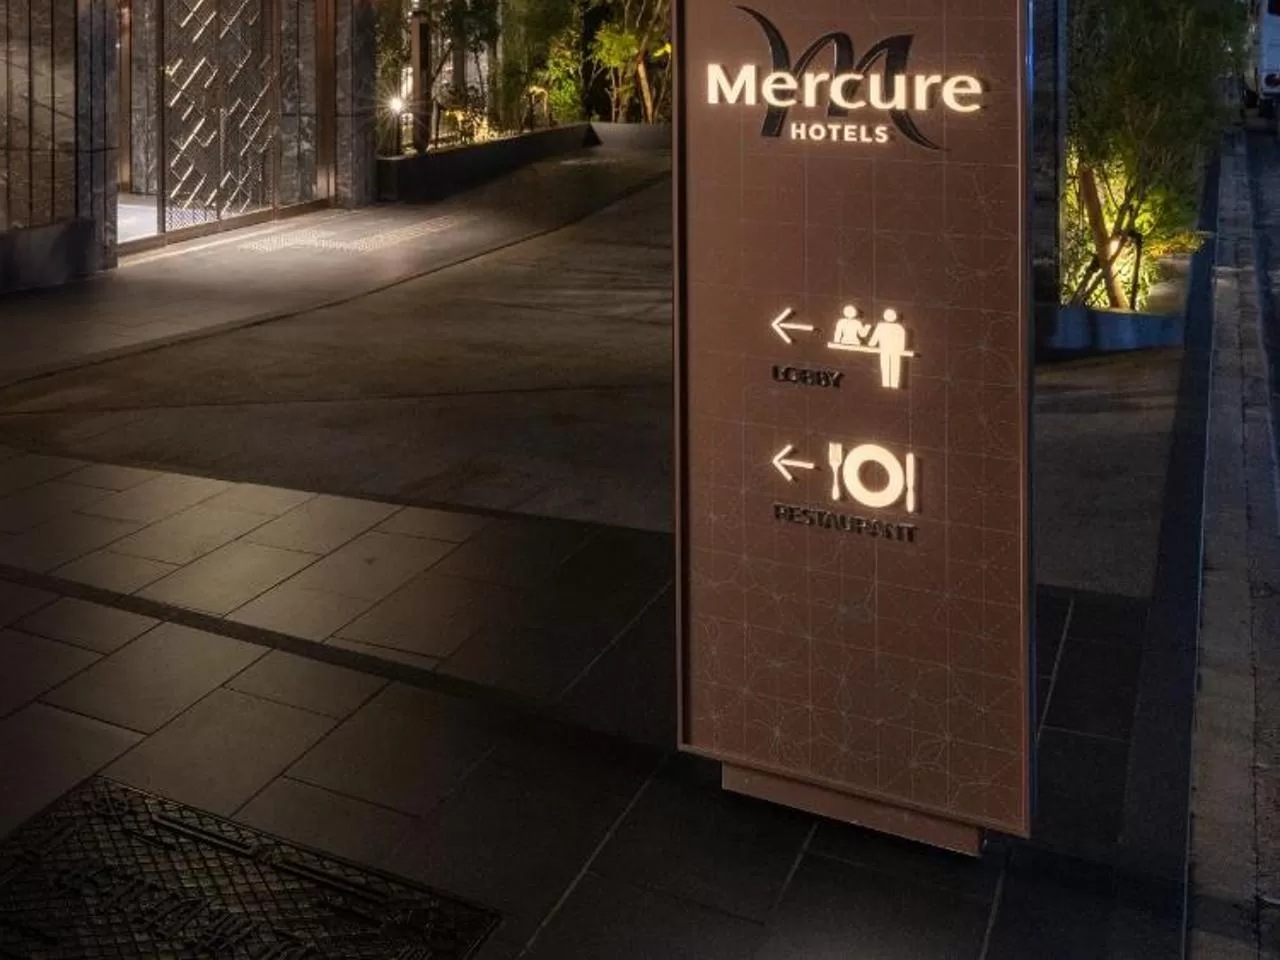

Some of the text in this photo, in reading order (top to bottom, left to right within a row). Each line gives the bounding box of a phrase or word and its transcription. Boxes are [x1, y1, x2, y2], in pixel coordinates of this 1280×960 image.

[707, 63, 984, 113] Mercure
[790, 122, 890, 144] HOTELS
[772, 365, 845, 388] LOBBY
[774, 504, 919, 541] RESTAURANT
